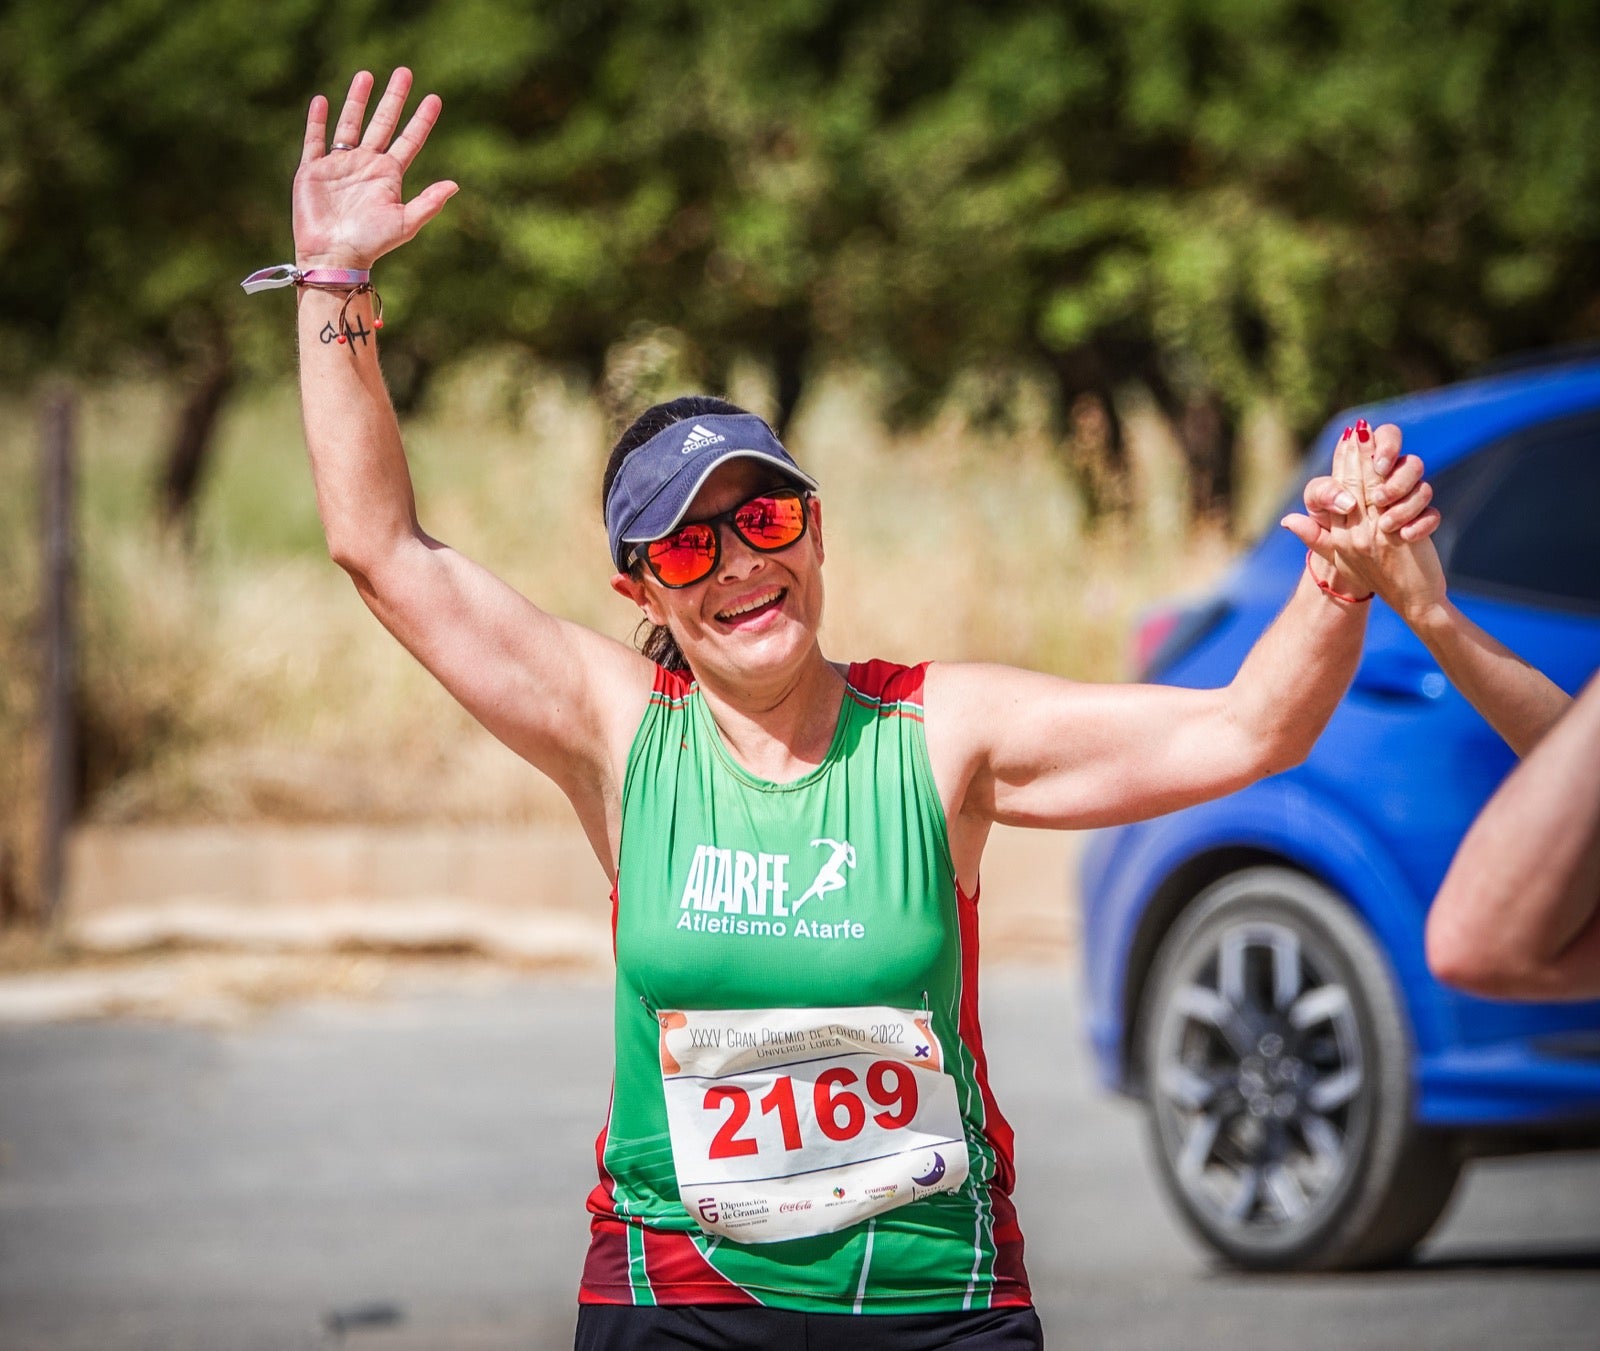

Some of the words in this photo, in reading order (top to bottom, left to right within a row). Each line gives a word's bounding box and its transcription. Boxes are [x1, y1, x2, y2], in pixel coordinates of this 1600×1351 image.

[682, 434, 726, 454] adidas
[680, 844, 790, 917] ATARFE
[676, 911, 787, 936] Atletismo
[793, 919, 866, 939] Atarfe
[690, 1028, 721, 1048] XXXV
[870, 1024, 905, 1044] 2022
[703, 1060, 919, 1160] 2169
[722, 1211, 732, 1220] de
[733, 1206, 770, 1218] Granada
